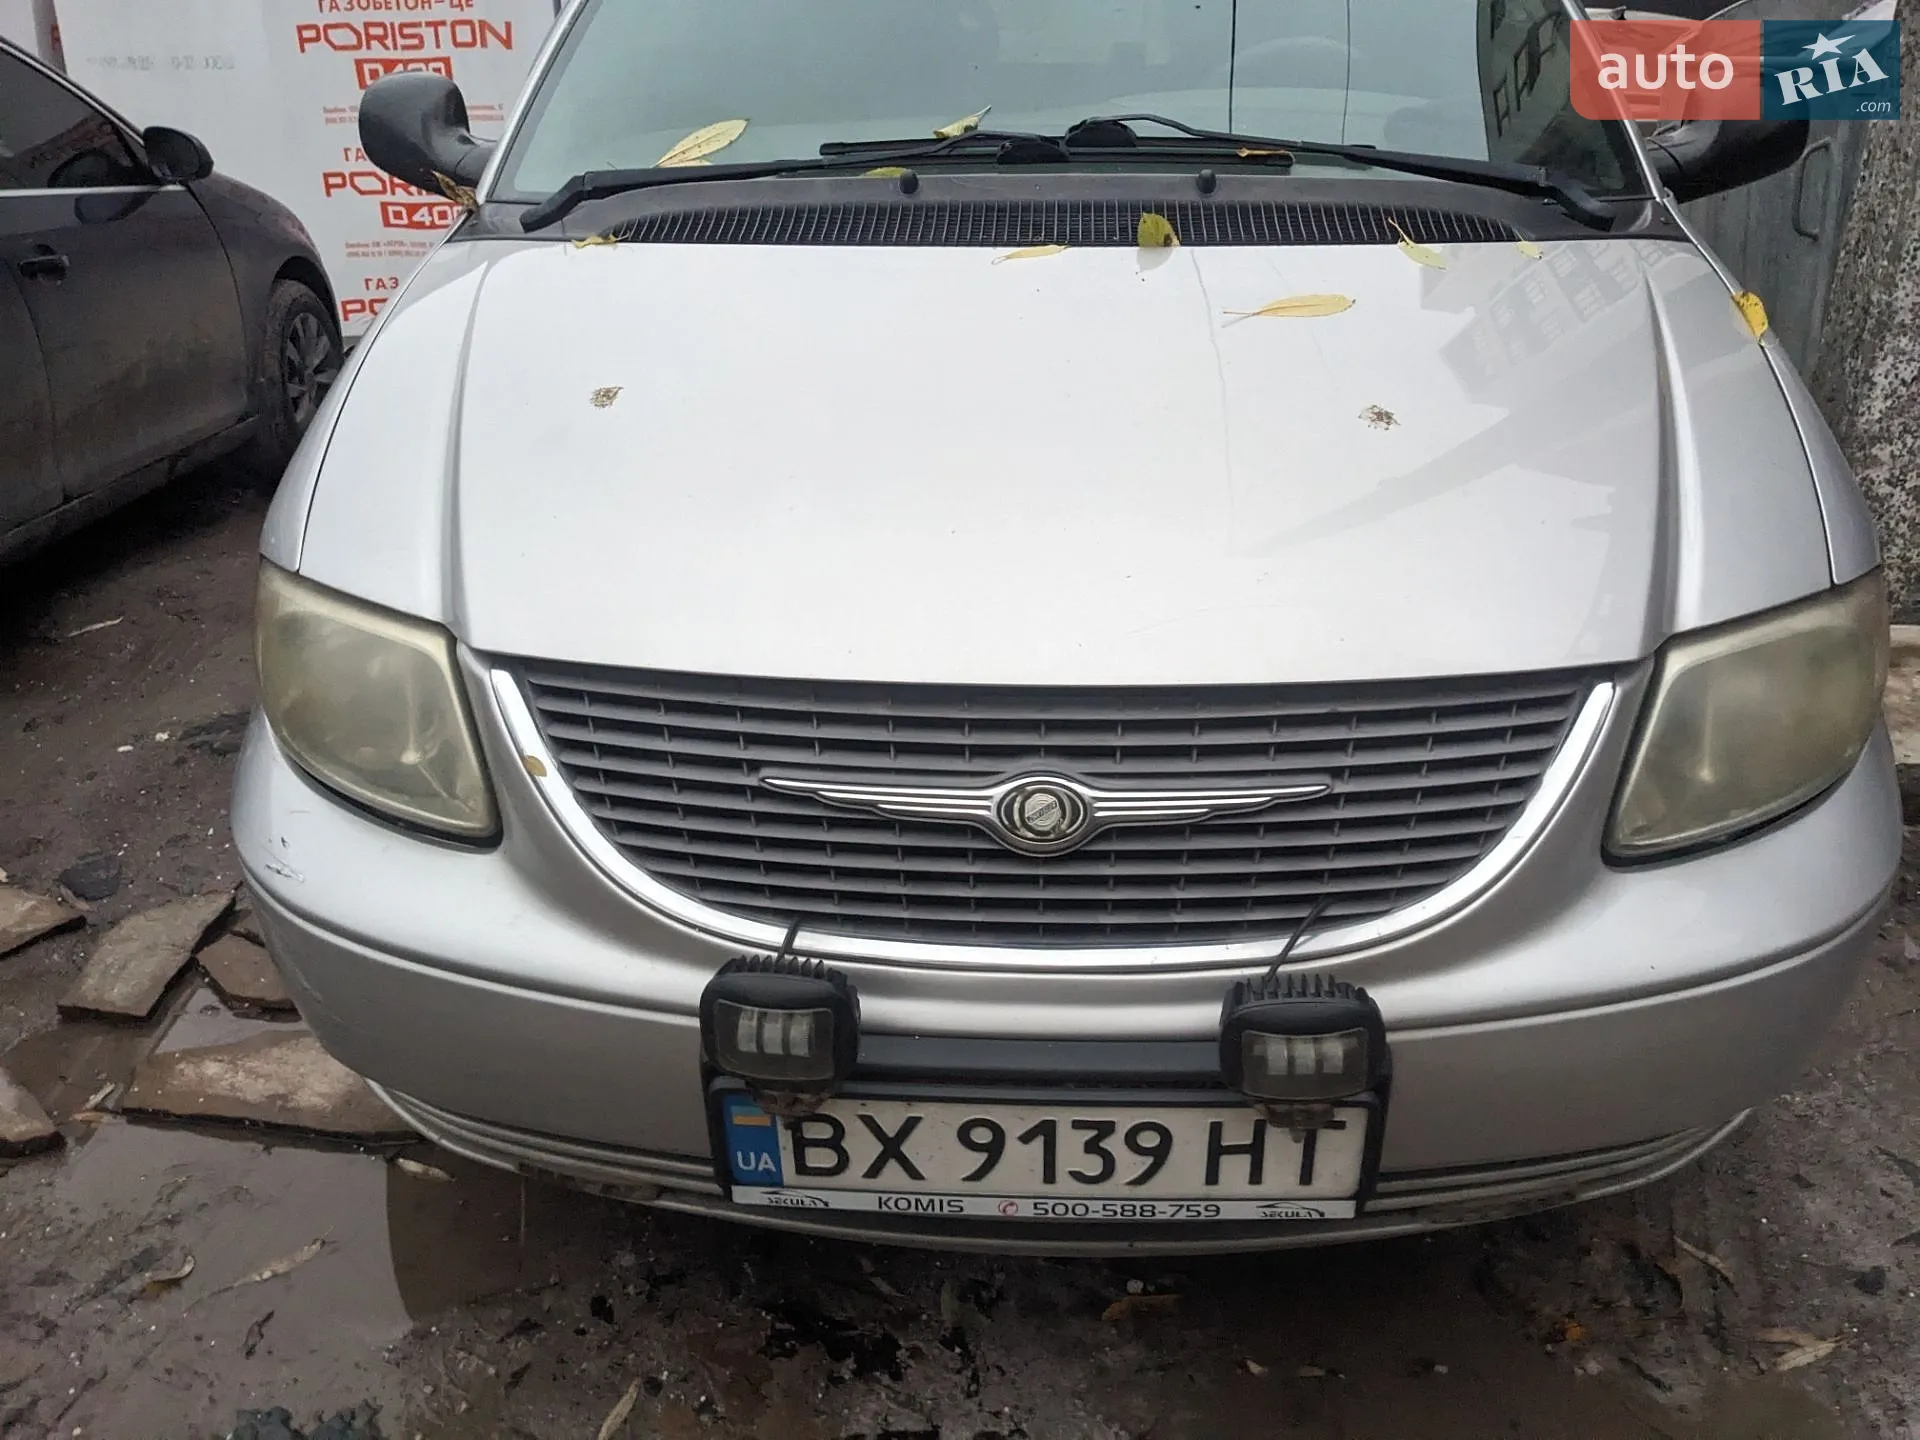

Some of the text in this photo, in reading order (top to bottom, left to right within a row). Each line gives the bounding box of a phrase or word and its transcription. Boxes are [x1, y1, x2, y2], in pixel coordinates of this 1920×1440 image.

[296, 19, 513, 53] PORISTON
[364, 277, 399, 291] ГАЗ
[790, 1113, 1347, 1186] BX 9139 HT
[736, 1151, 777, 1173] UA
[877, 1196, 965, 1213] KOMIS
[1033, 1202, 1221, 1219] 500-588-759
